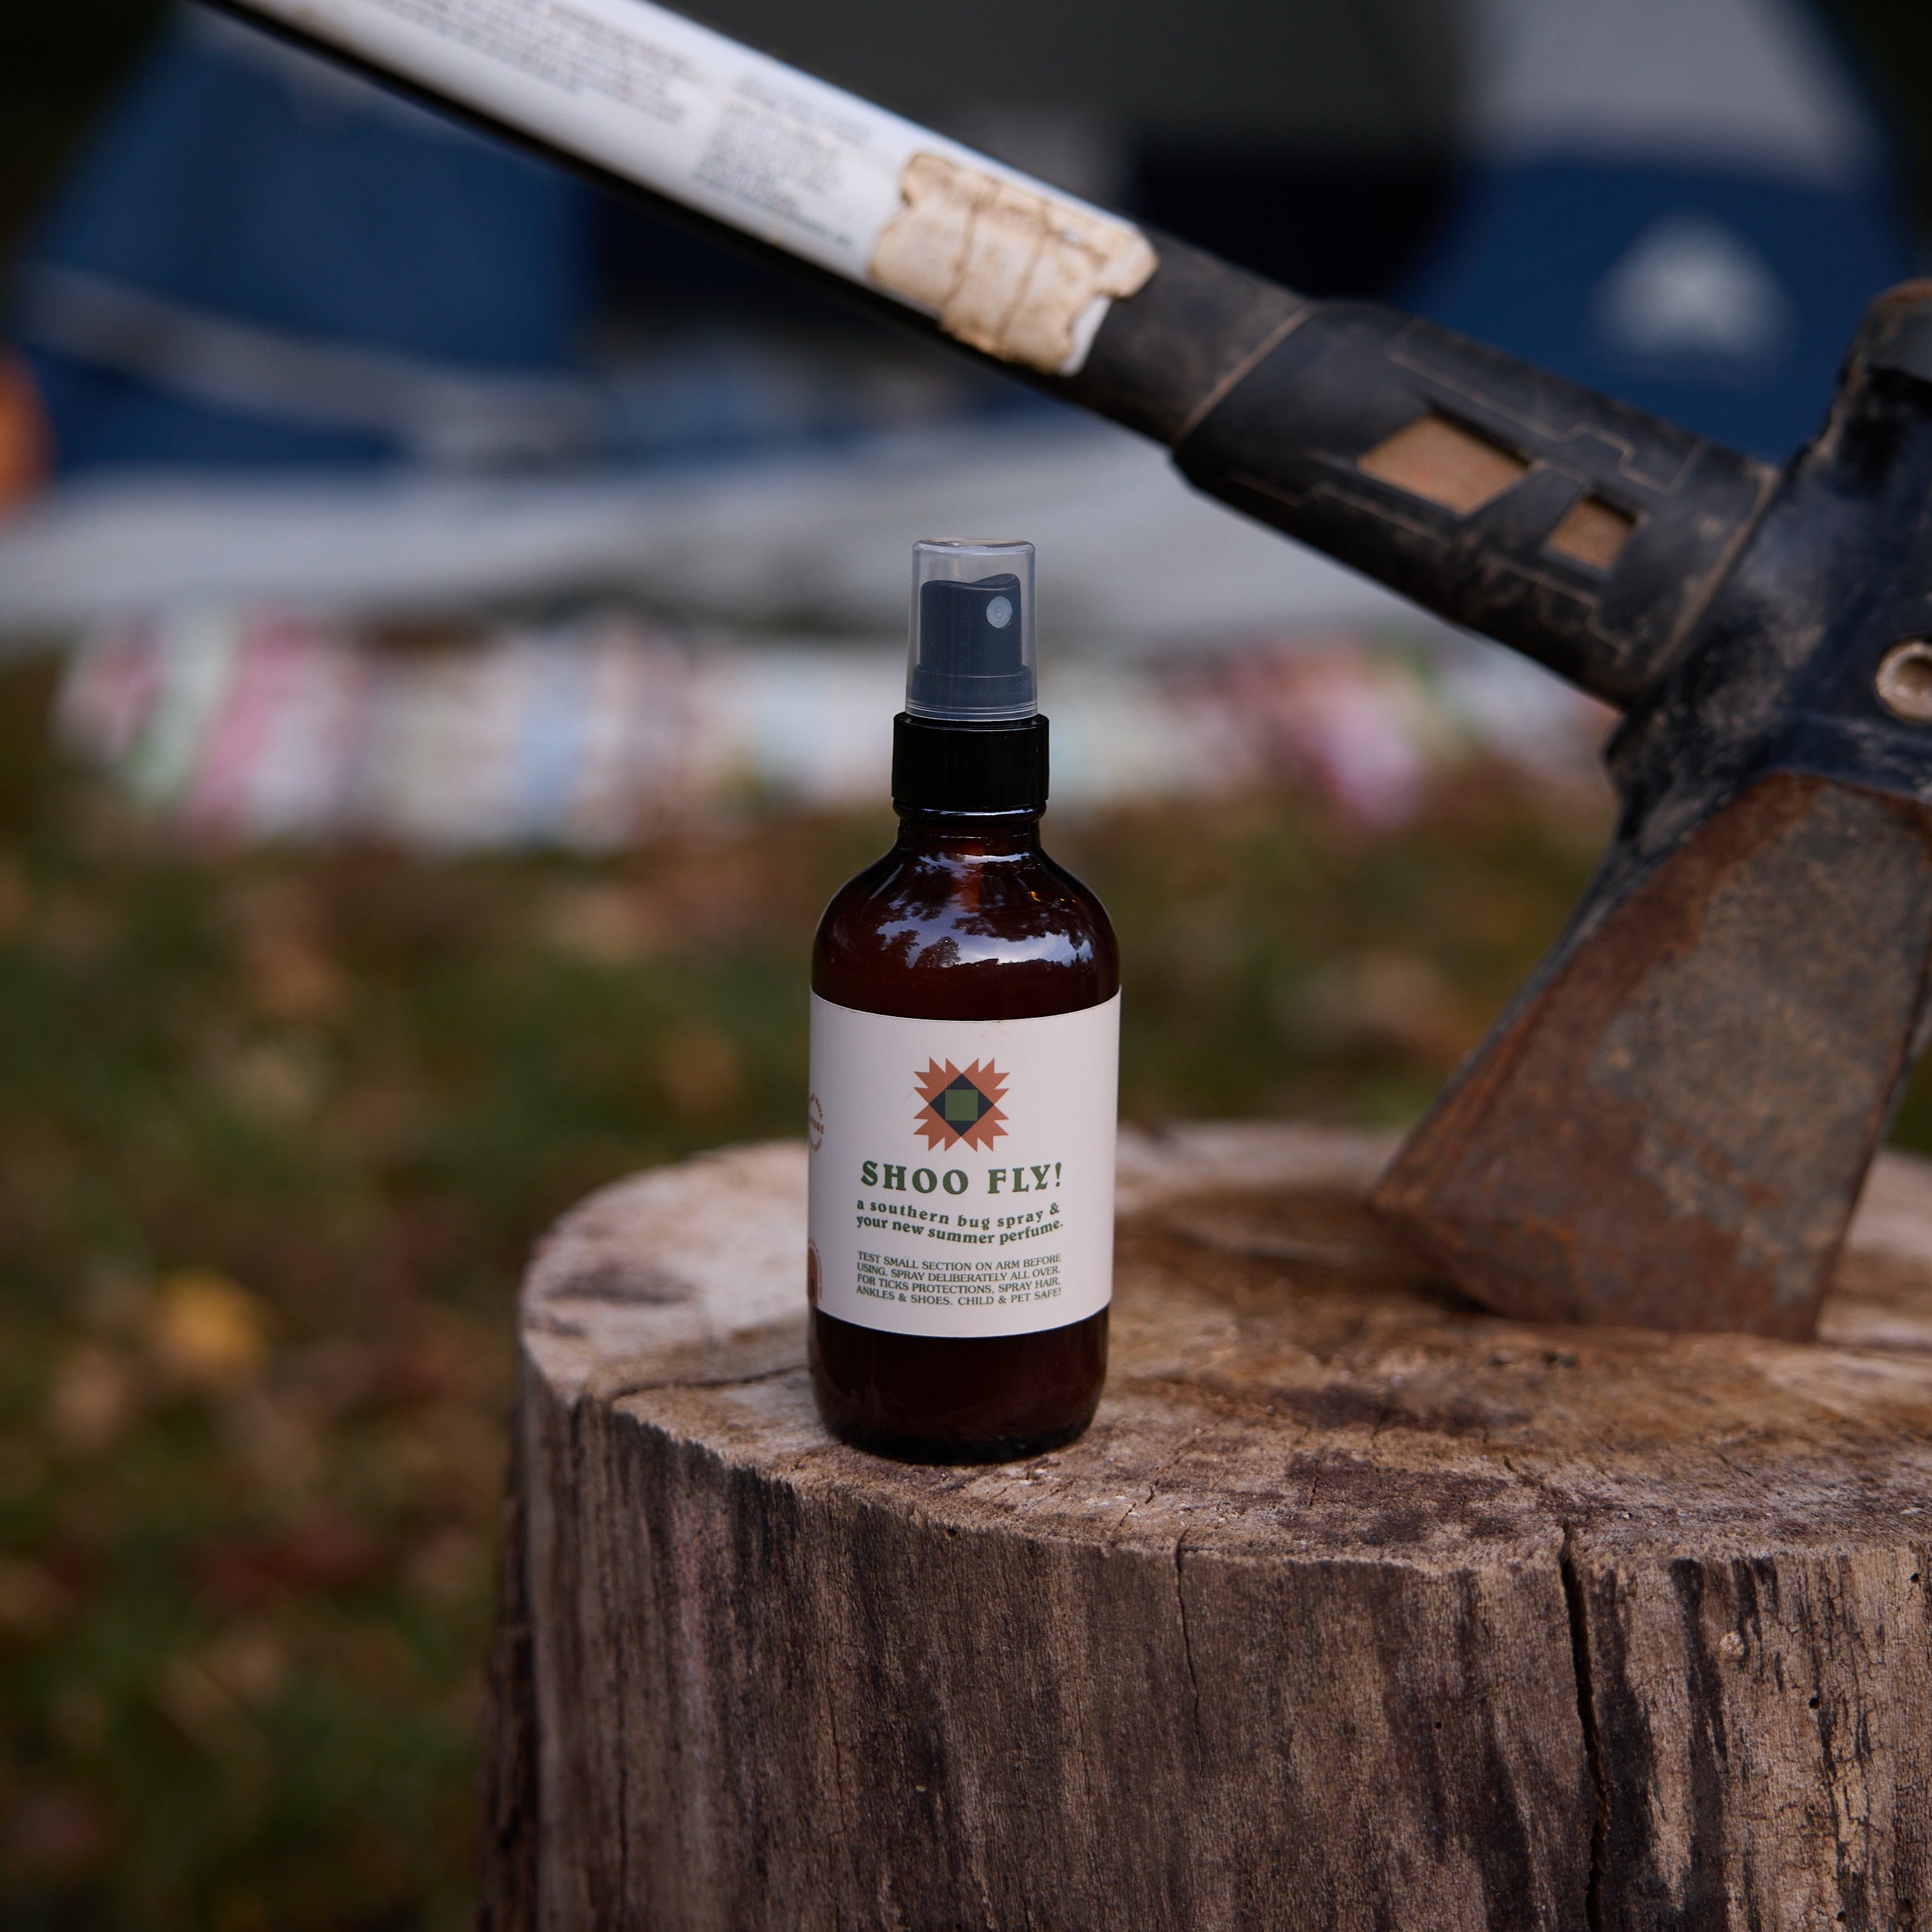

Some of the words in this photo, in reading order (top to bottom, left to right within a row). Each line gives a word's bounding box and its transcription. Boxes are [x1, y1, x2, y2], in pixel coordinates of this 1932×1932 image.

[859, 1159, 970, 1196] SHOO
[986, 1161, 1063, 1195] FLY!
[856, 1199, 865, 1210] a
[870, 1200, 951, 1226] southern
[957, 1214, 991, 1230] bug
[997, 1209, 1044, 1229] spray
[1049, 1202, 1060, 1215] &
[855, 1213, 888, 1228] your
[892, 1221, 924, 1235] new
[927, 1229, 995, 1243] summer
[998, 1219, 1063, 1246] perfume.
[857, 1251, 881, 1263] TEST
[883, 1256, 919, 1269] SMALL
[921, 1260, 972, 1271] SECTION
[975, 1261, 992, 1271] ON
[995, 1260, 1020, 1270] ARM
[1023, 1253, 1062, 1267] BEFORE
[856, 1274, 876, 1284] FOR
[878, 1277, 909, 1291] TICKS
[998, 1281, 1032, 1293] SPRAY
[890, 1269, 925, 1281] SPRAY
[927, 1272, 1007, 1282] DELIBERATELY
[1009, 1271, 1029, 1280] ALL
[856, 1284, 895, 1300] ANKLES
[910, 1294, 954, 1304] SHOES.
[957, 1297, 994, 1305] CHILD
[997, 1295, 1007, 1304] &
[1011, 1294, 1031, 1303] PET
[1033, 1288, 1061, 1300] SAFE!
